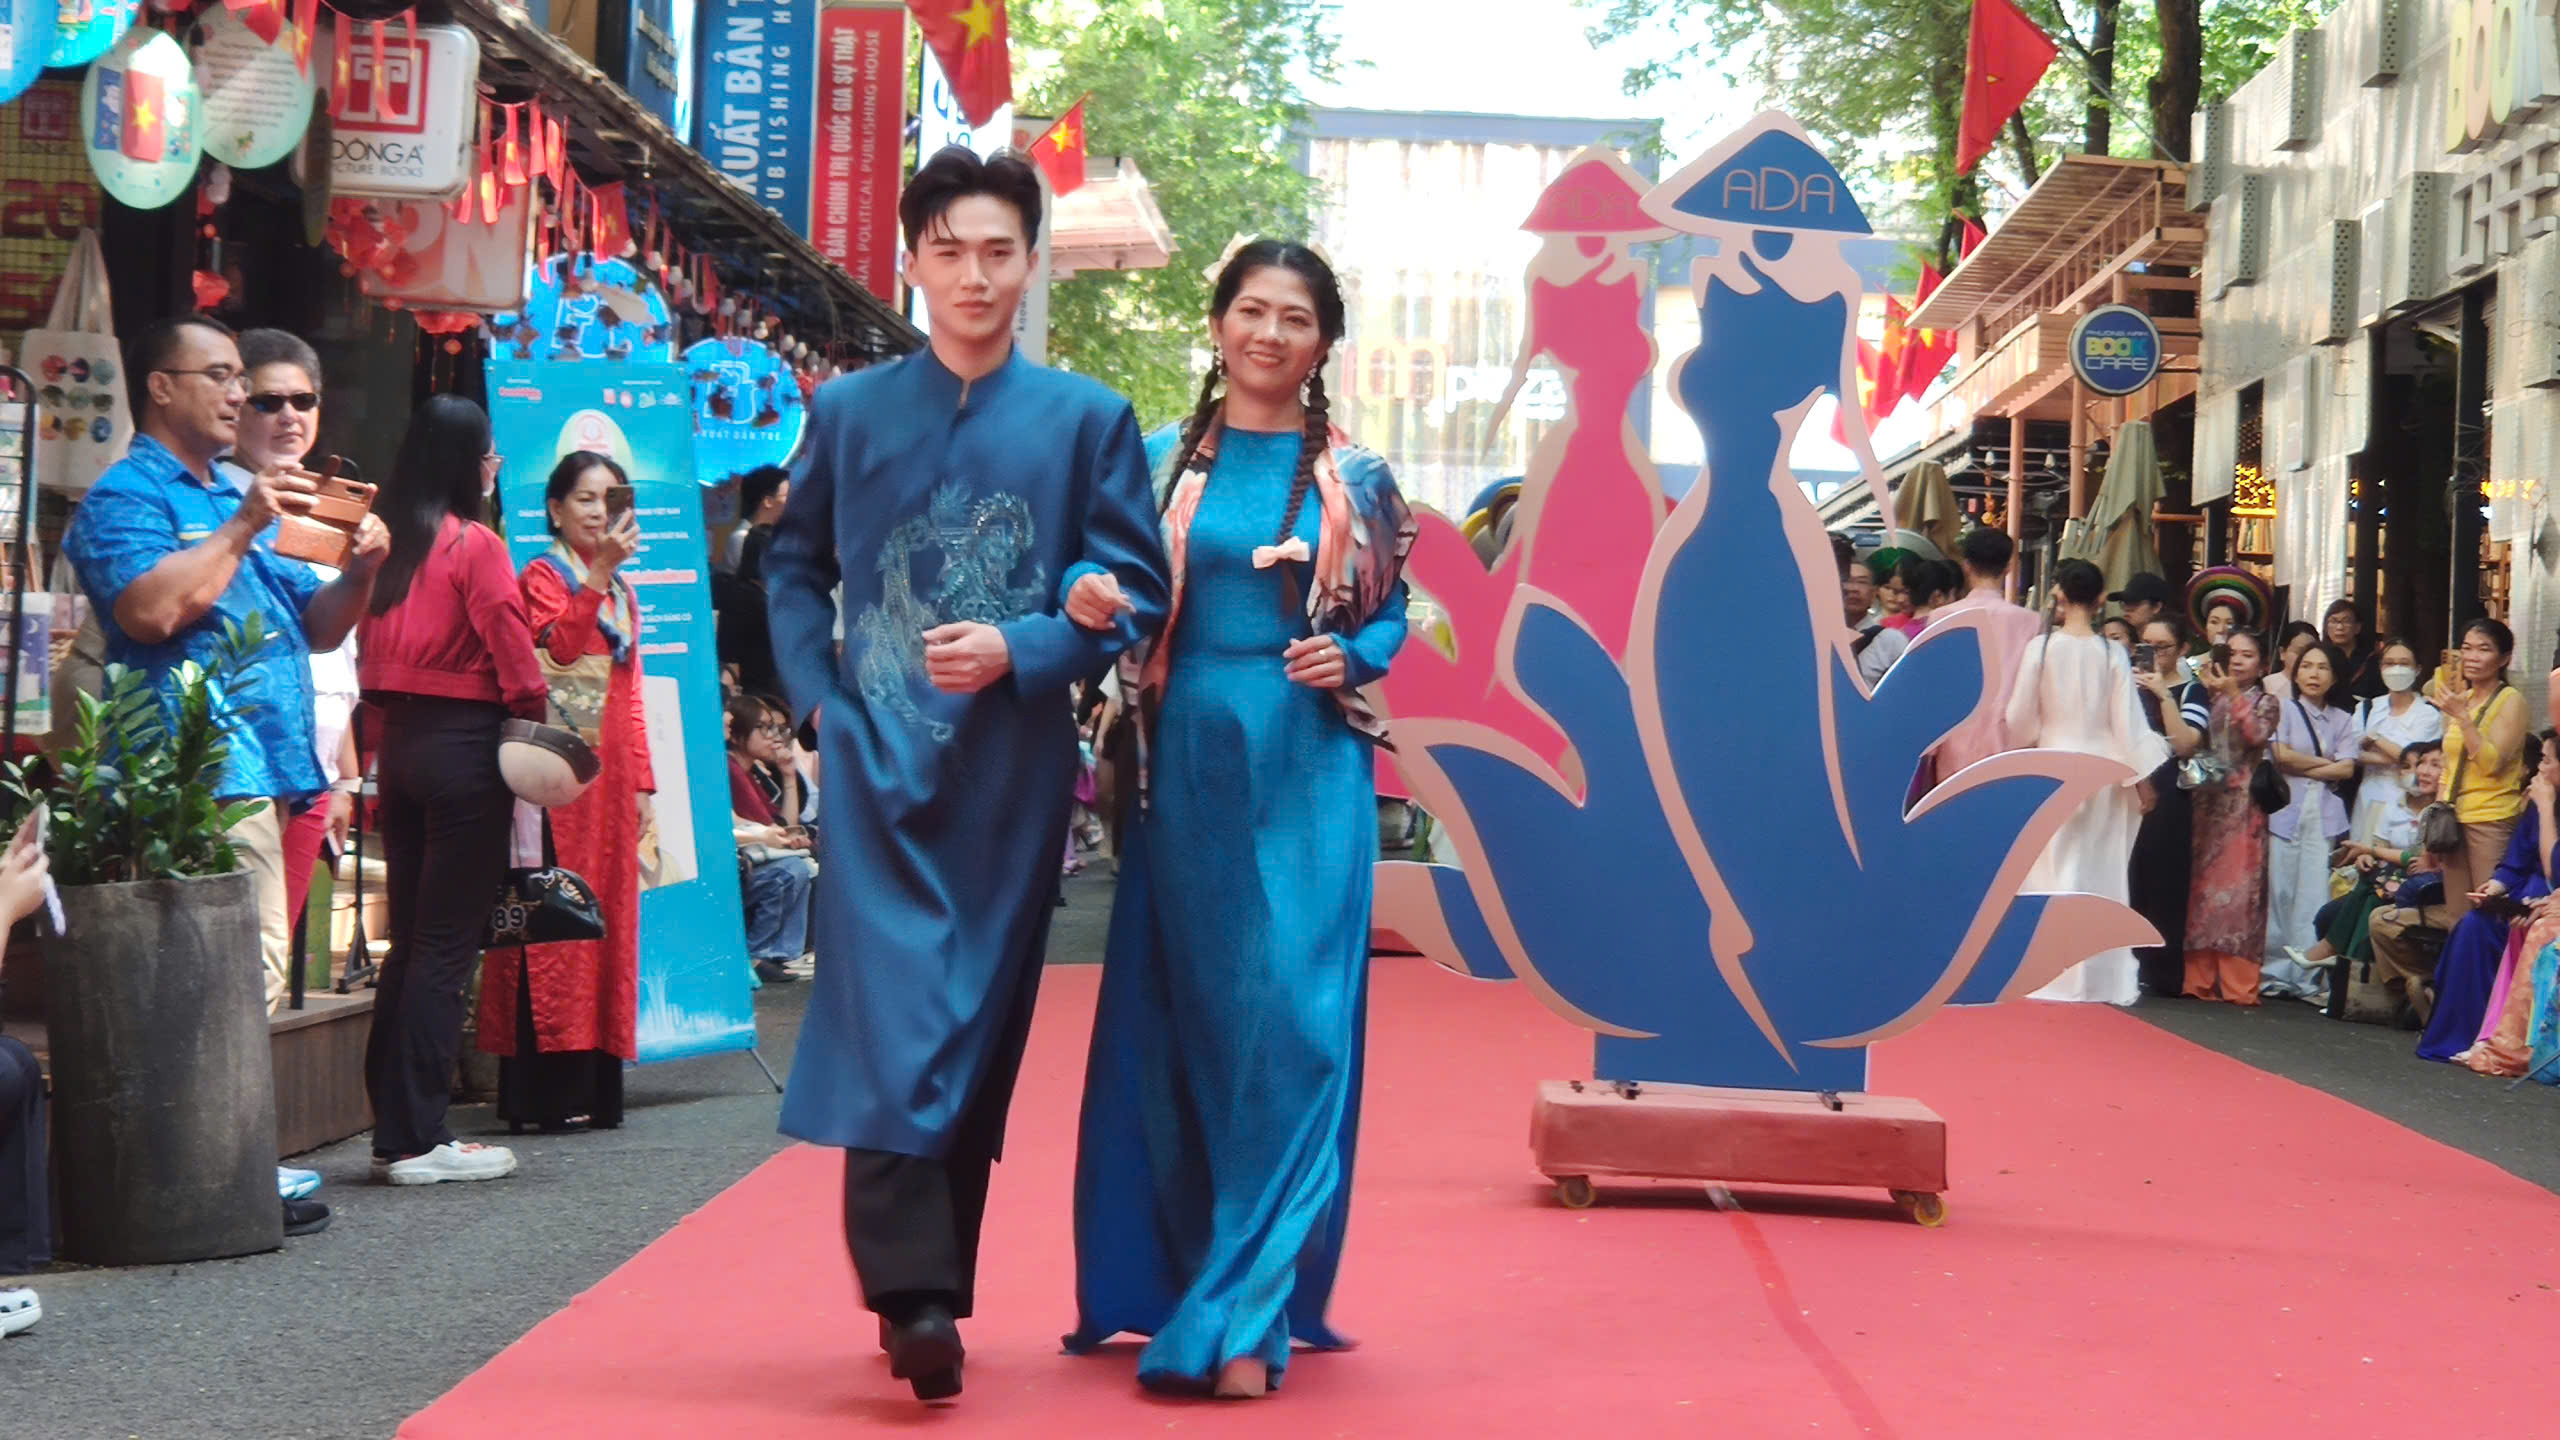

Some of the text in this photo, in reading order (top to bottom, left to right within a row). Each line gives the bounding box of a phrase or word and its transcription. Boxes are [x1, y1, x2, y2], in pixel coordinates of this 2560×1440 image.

[713, 17, 764, 94] BẢN
[828, 27, 858, 62] THẬT
[863, 29, 881, 81] HOUSE
[831, 63, 858, 85] SỰ
[831, 87, 853, 112] GIA
[824, 114, 853, 153] QUỐC
[860, 83, 879, 173] PUBLISHING
[1722, 166, 1835, 214] ADA
[856, 177, 873, 252] POLITICAL
[2085, 356, 2149, 371] CAFE
[2086, 336, 2150, 357] BOOK
[493, 905, 527, 931] 89
